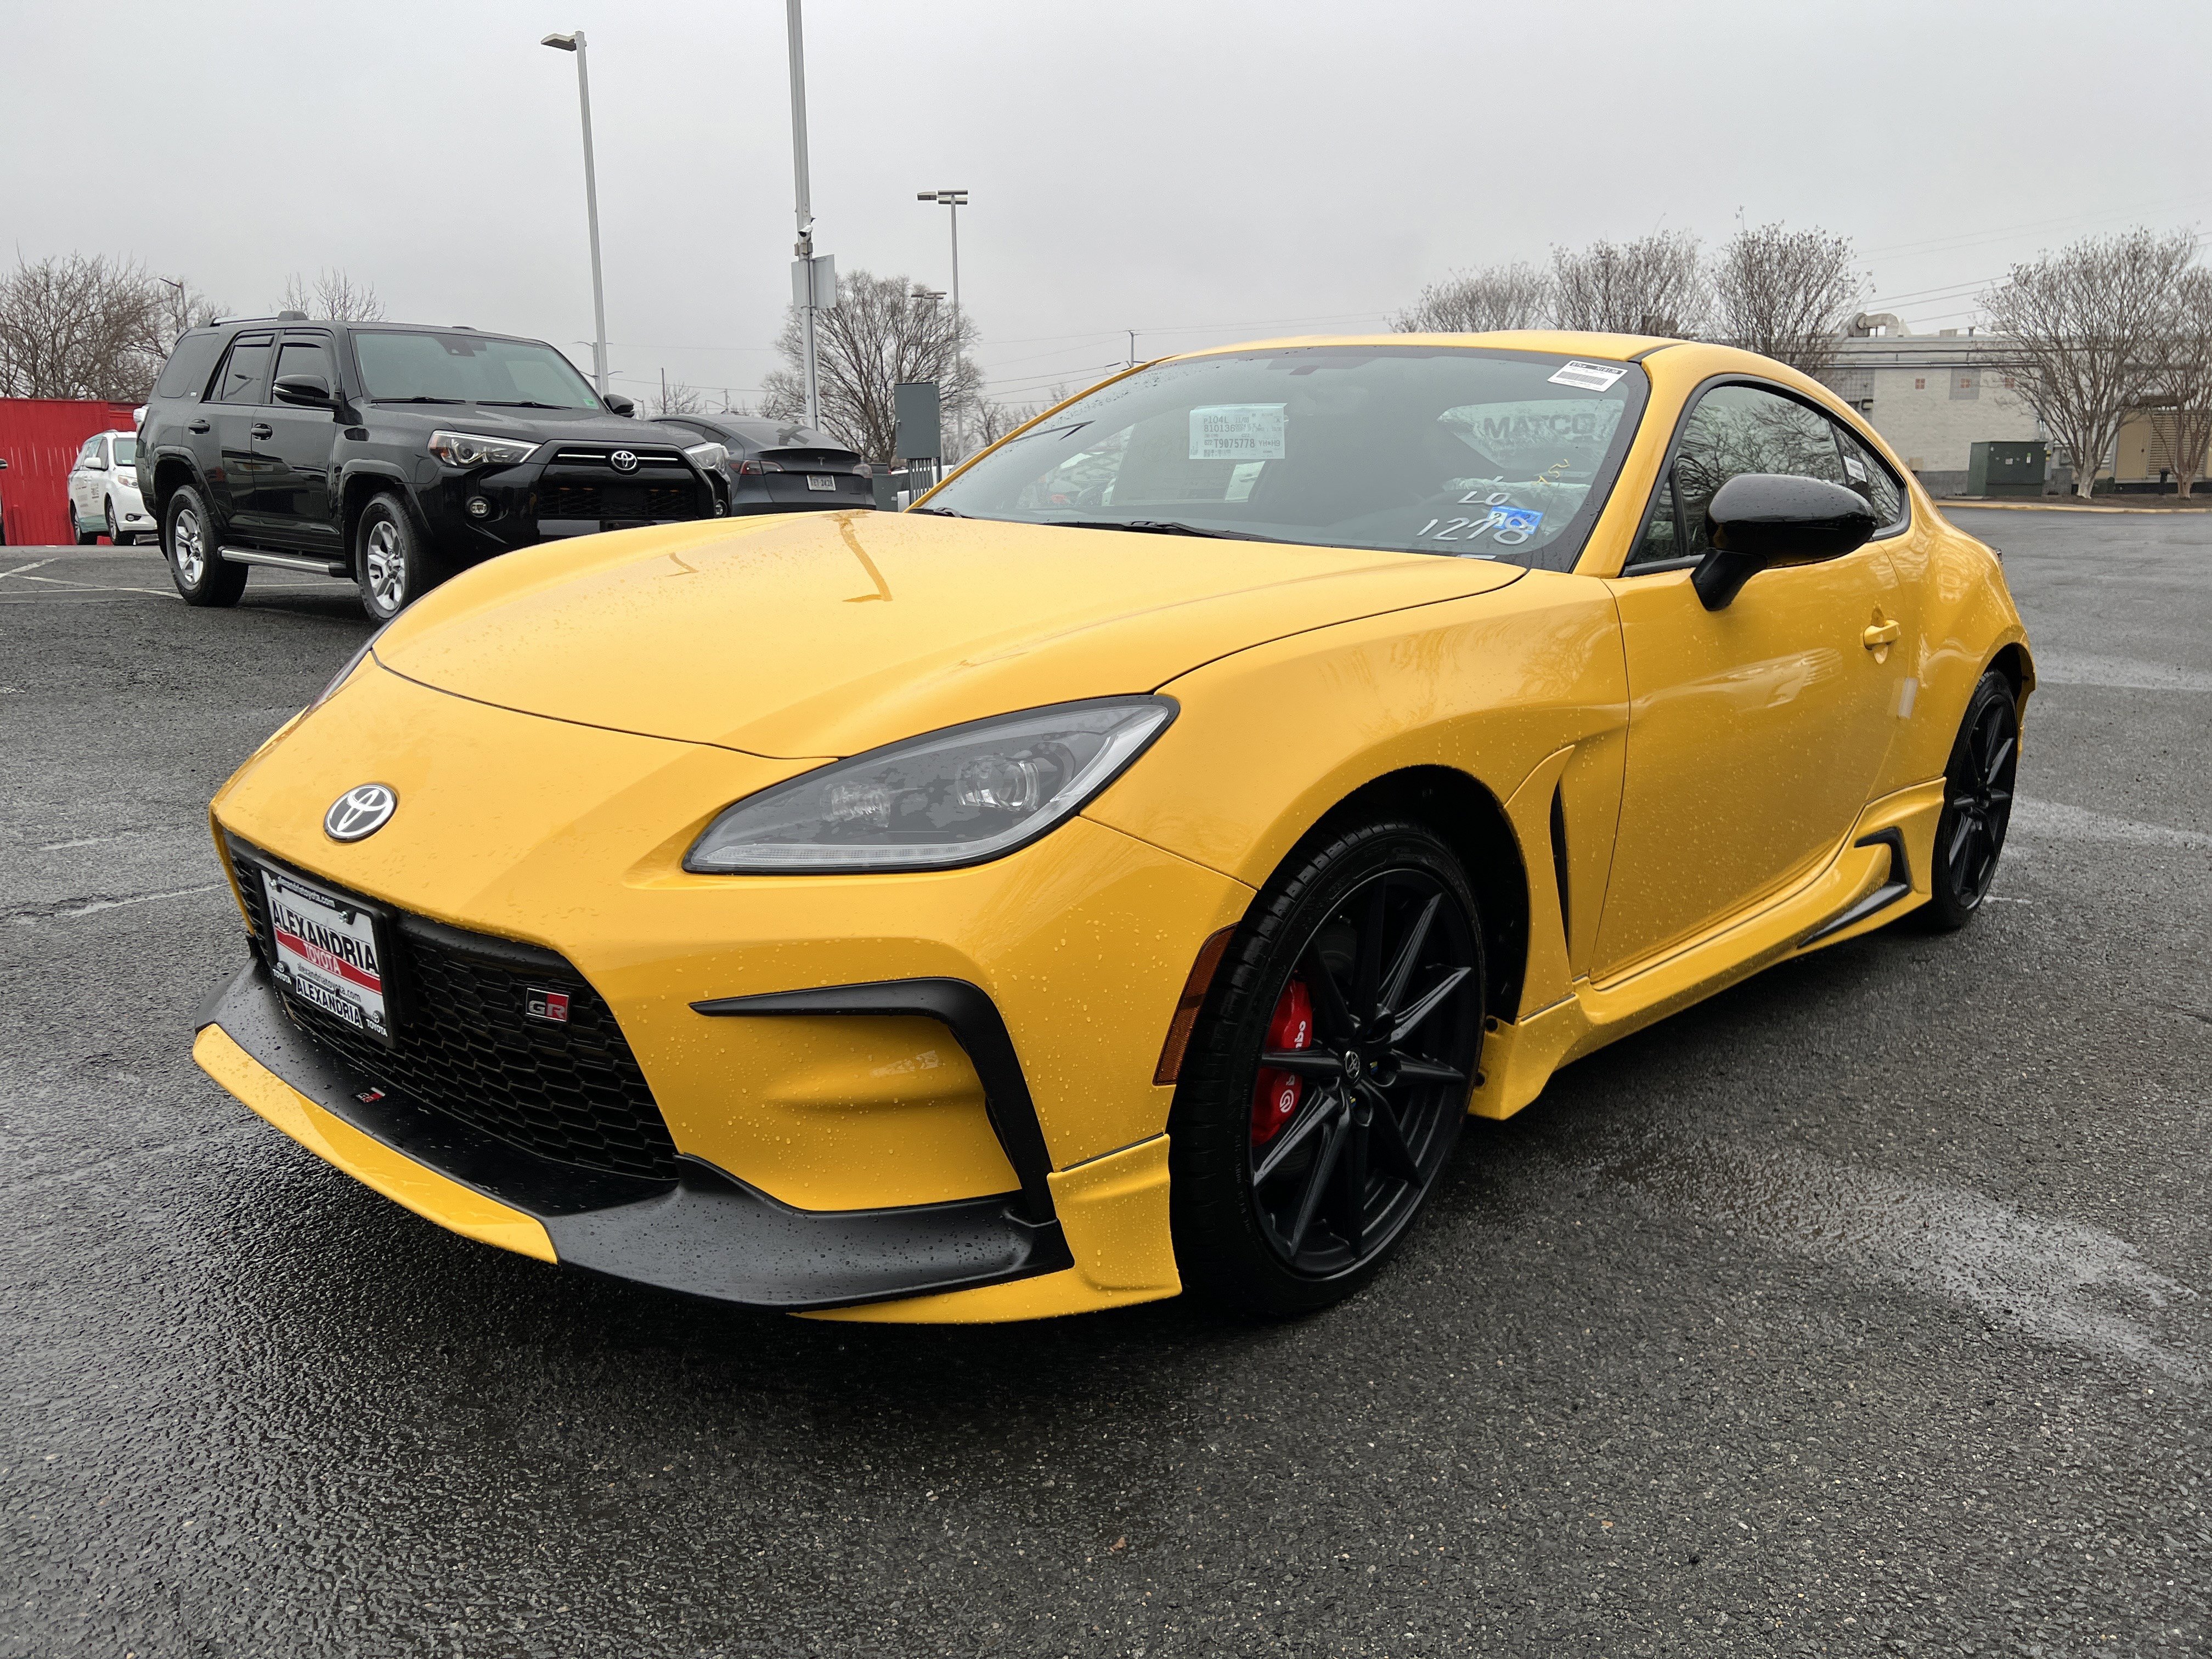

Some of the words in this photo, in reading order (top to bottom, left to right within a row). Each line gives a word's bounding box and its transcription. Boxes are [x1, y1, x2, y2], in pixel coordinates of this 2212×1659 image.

[1204, 424, 1235, 432] 810136
[273, 900, 380, 975] ALEXANDRIA
[303, 942, 342, 975] TOYOTA
[273, 969, 292, 985] TOYOTA
[297, 977, 362, 1027] ALEXANDRIA
[528, 1000, 565, 1019] GR
[366, 1019, 388, 1037] TOYOTA
